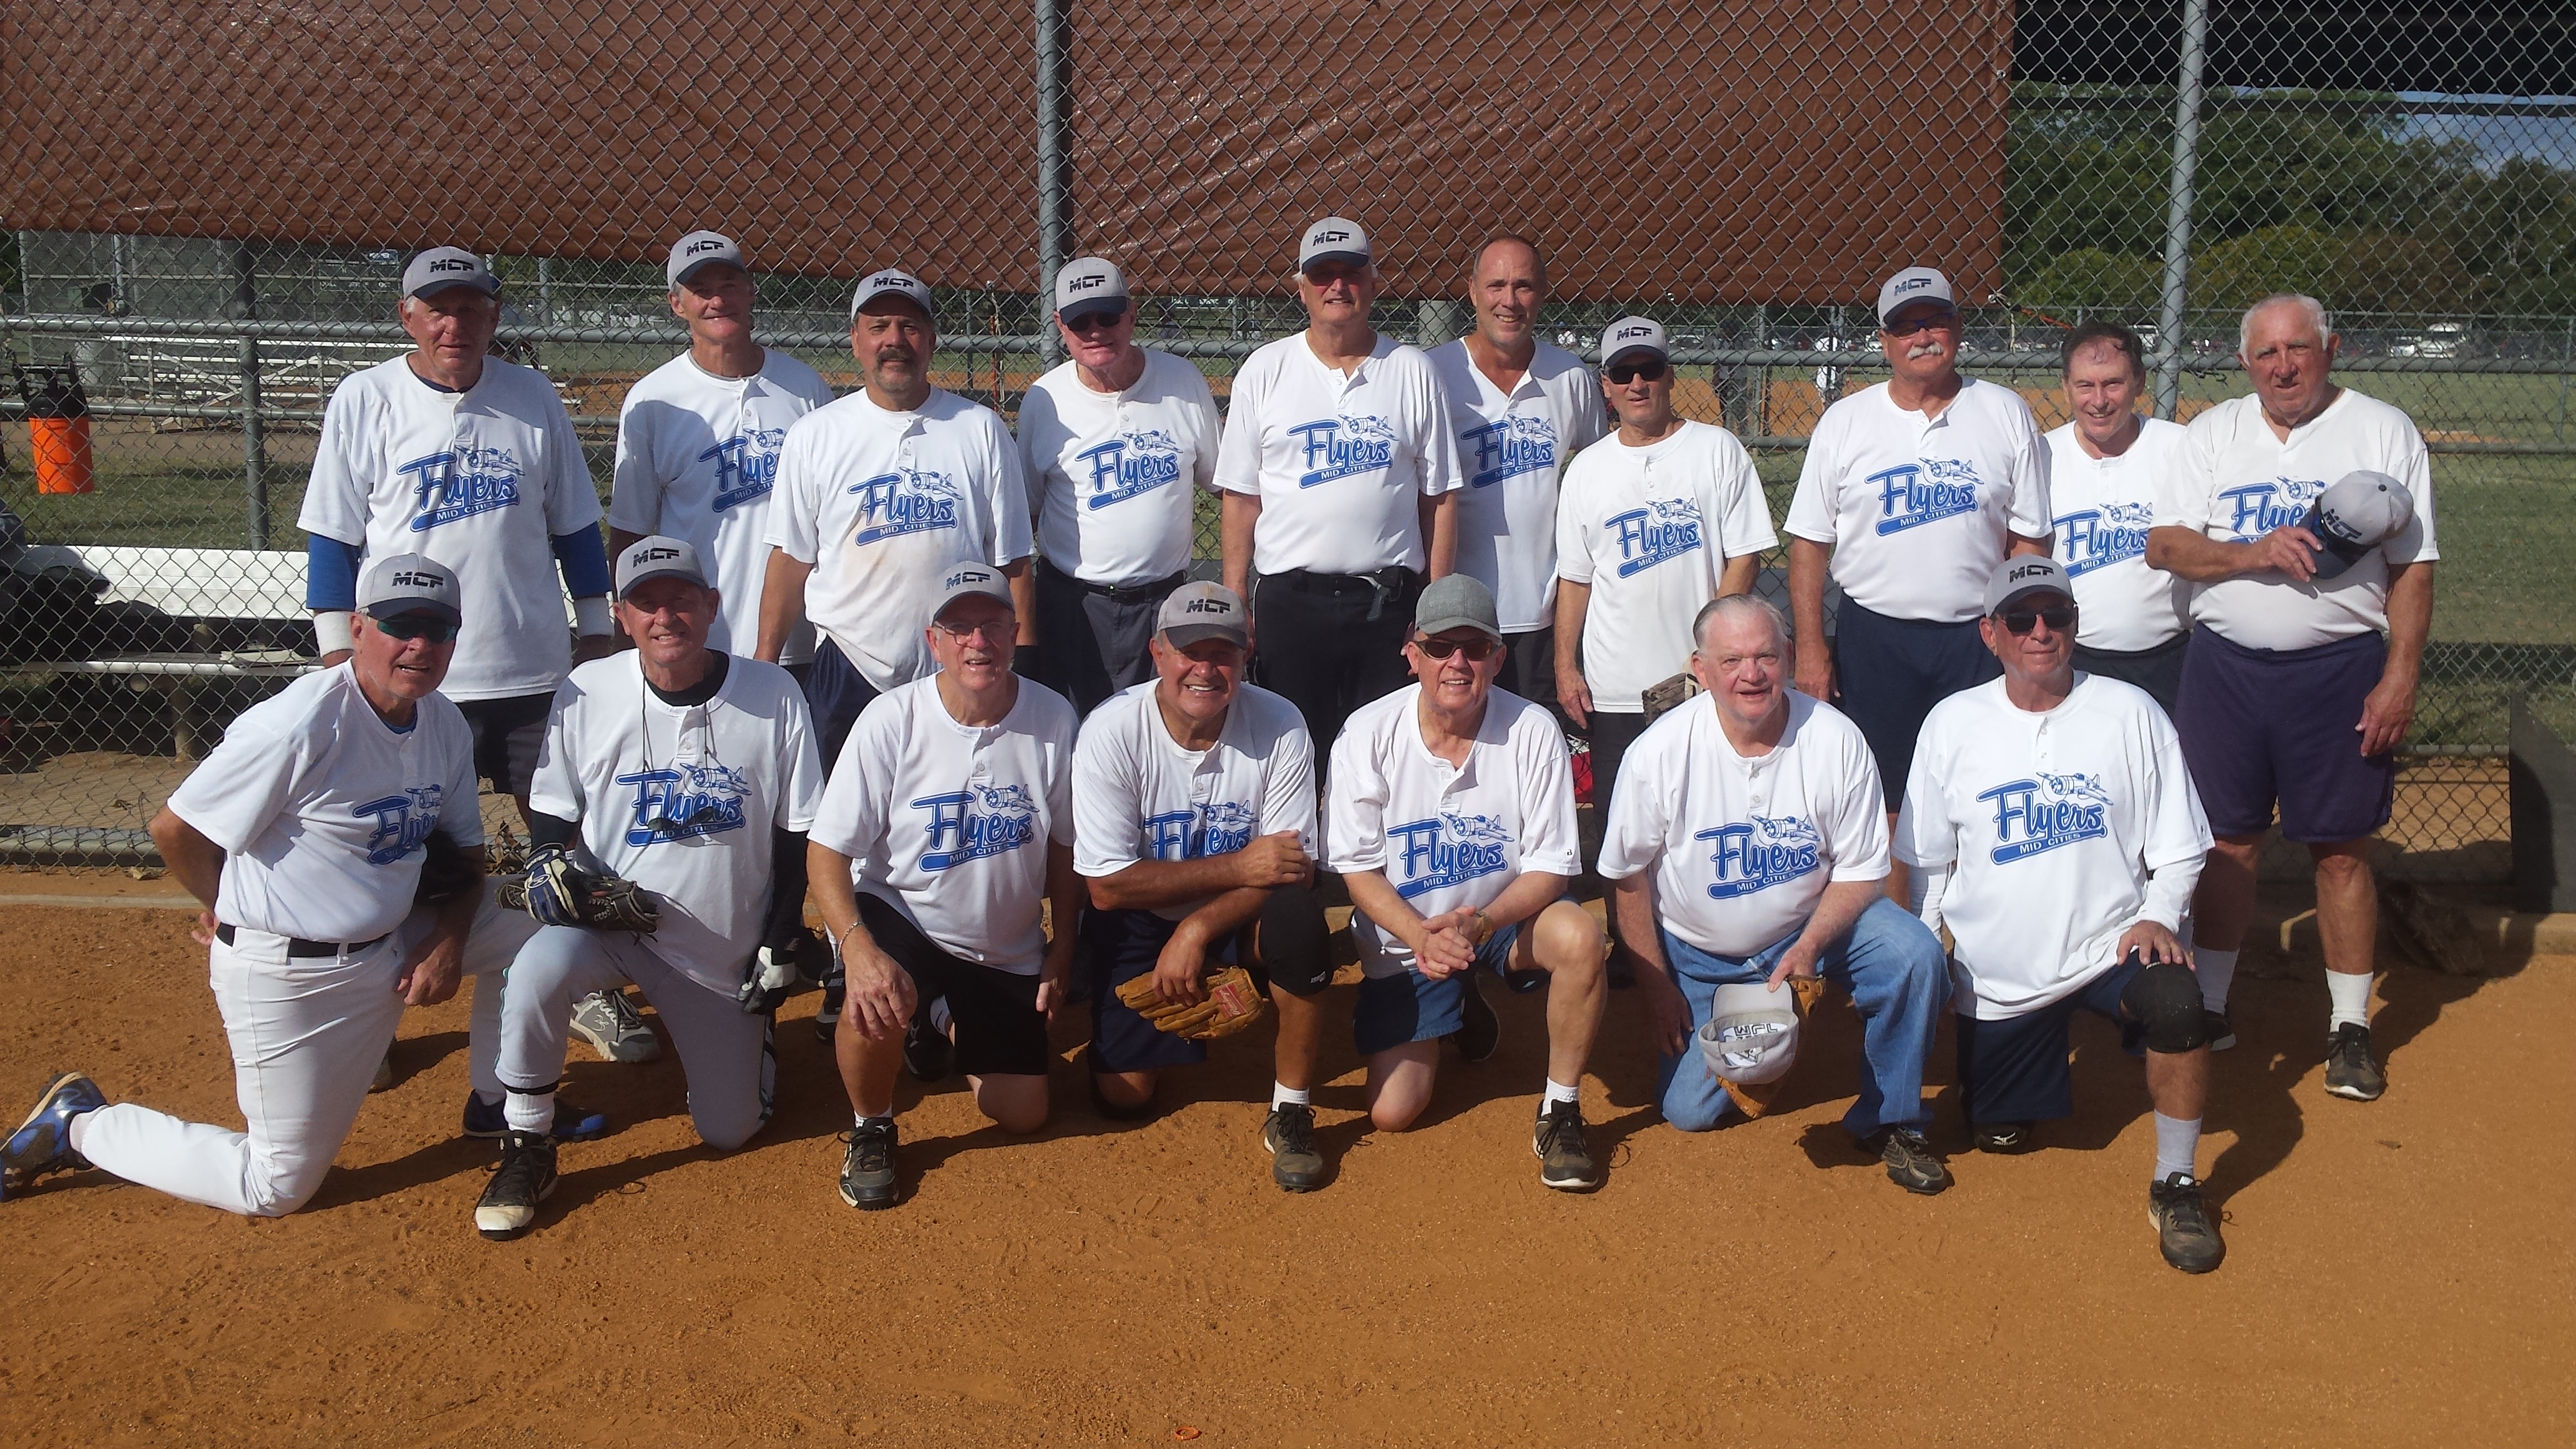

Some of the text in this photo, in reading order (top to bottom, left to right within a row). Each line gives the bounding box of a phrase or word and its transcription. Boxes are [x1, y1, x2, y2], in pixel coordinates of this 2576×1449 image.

[1312, 230, 1349, 246] MCF
[686, 240, 724, 256] MCF
[429, 258, 474, 273] MCF
[873, 277, 914, 288] MCF
[1069, 275, 1105, 293] MCF
[1894, 278, 1932, 296] MCF
[1616, 326, 1652, 341] MCF
[1287, 419, 1390, 469] Flyers
[1461, 420, 1553, 471] Flyers
[698, 436, 780, 492] Flye
[1075, 440, 1178, 492] Flyers
[396, 451, 517, 510] Flyers
[1321, 469, 1339, 479] MID
[1495, 469, 1511, 478] MID
[734, 482, 774, 499] MID CITI
[847, 472, 954, 525] Flyers
[1111, 489, 1130, 500] MID
[1865, 464, 1975, 516] Flyers
[437, 510, 459, 520] MID
[2217, 482, 2309, 533] Flye
[1900, 515, 1920, 527] MID
[880, 525, 899, 536] MID
[1604, 508, 1698, 559] Flyers
[2052, 509, 2148, 561] Flyers
[633, 547, 680, 568] MCF
[1637, 557, 1654, 568] MID
[2081, 560, 2100, 571] MID
[392, 572, 444, 588] MCF
[946, 572, 990, 590] MCF
[2009, 565, 2054, 583] MCF
[1186, 599, 1230, 613] MCF
[616, 769, 743, 826] Flyers
[1976, 779, 2104, 842] Flyers
[353, 796, 436, 851] Flye
[910, 791, 1032, 851] Flyers
[653, 830, 675, 839] MID
[1145, 811, 1252, 861] Flyers
[1387, 817, 1503, 879] Flyers
[1694, 822, 1817, 880] Flyers
[2019, 842, 2042, 854] MID
[949, 851, 970, 864] MID
[1423, 877, 1443, 888] MID
[1737, 881, 1757, 892] MID
